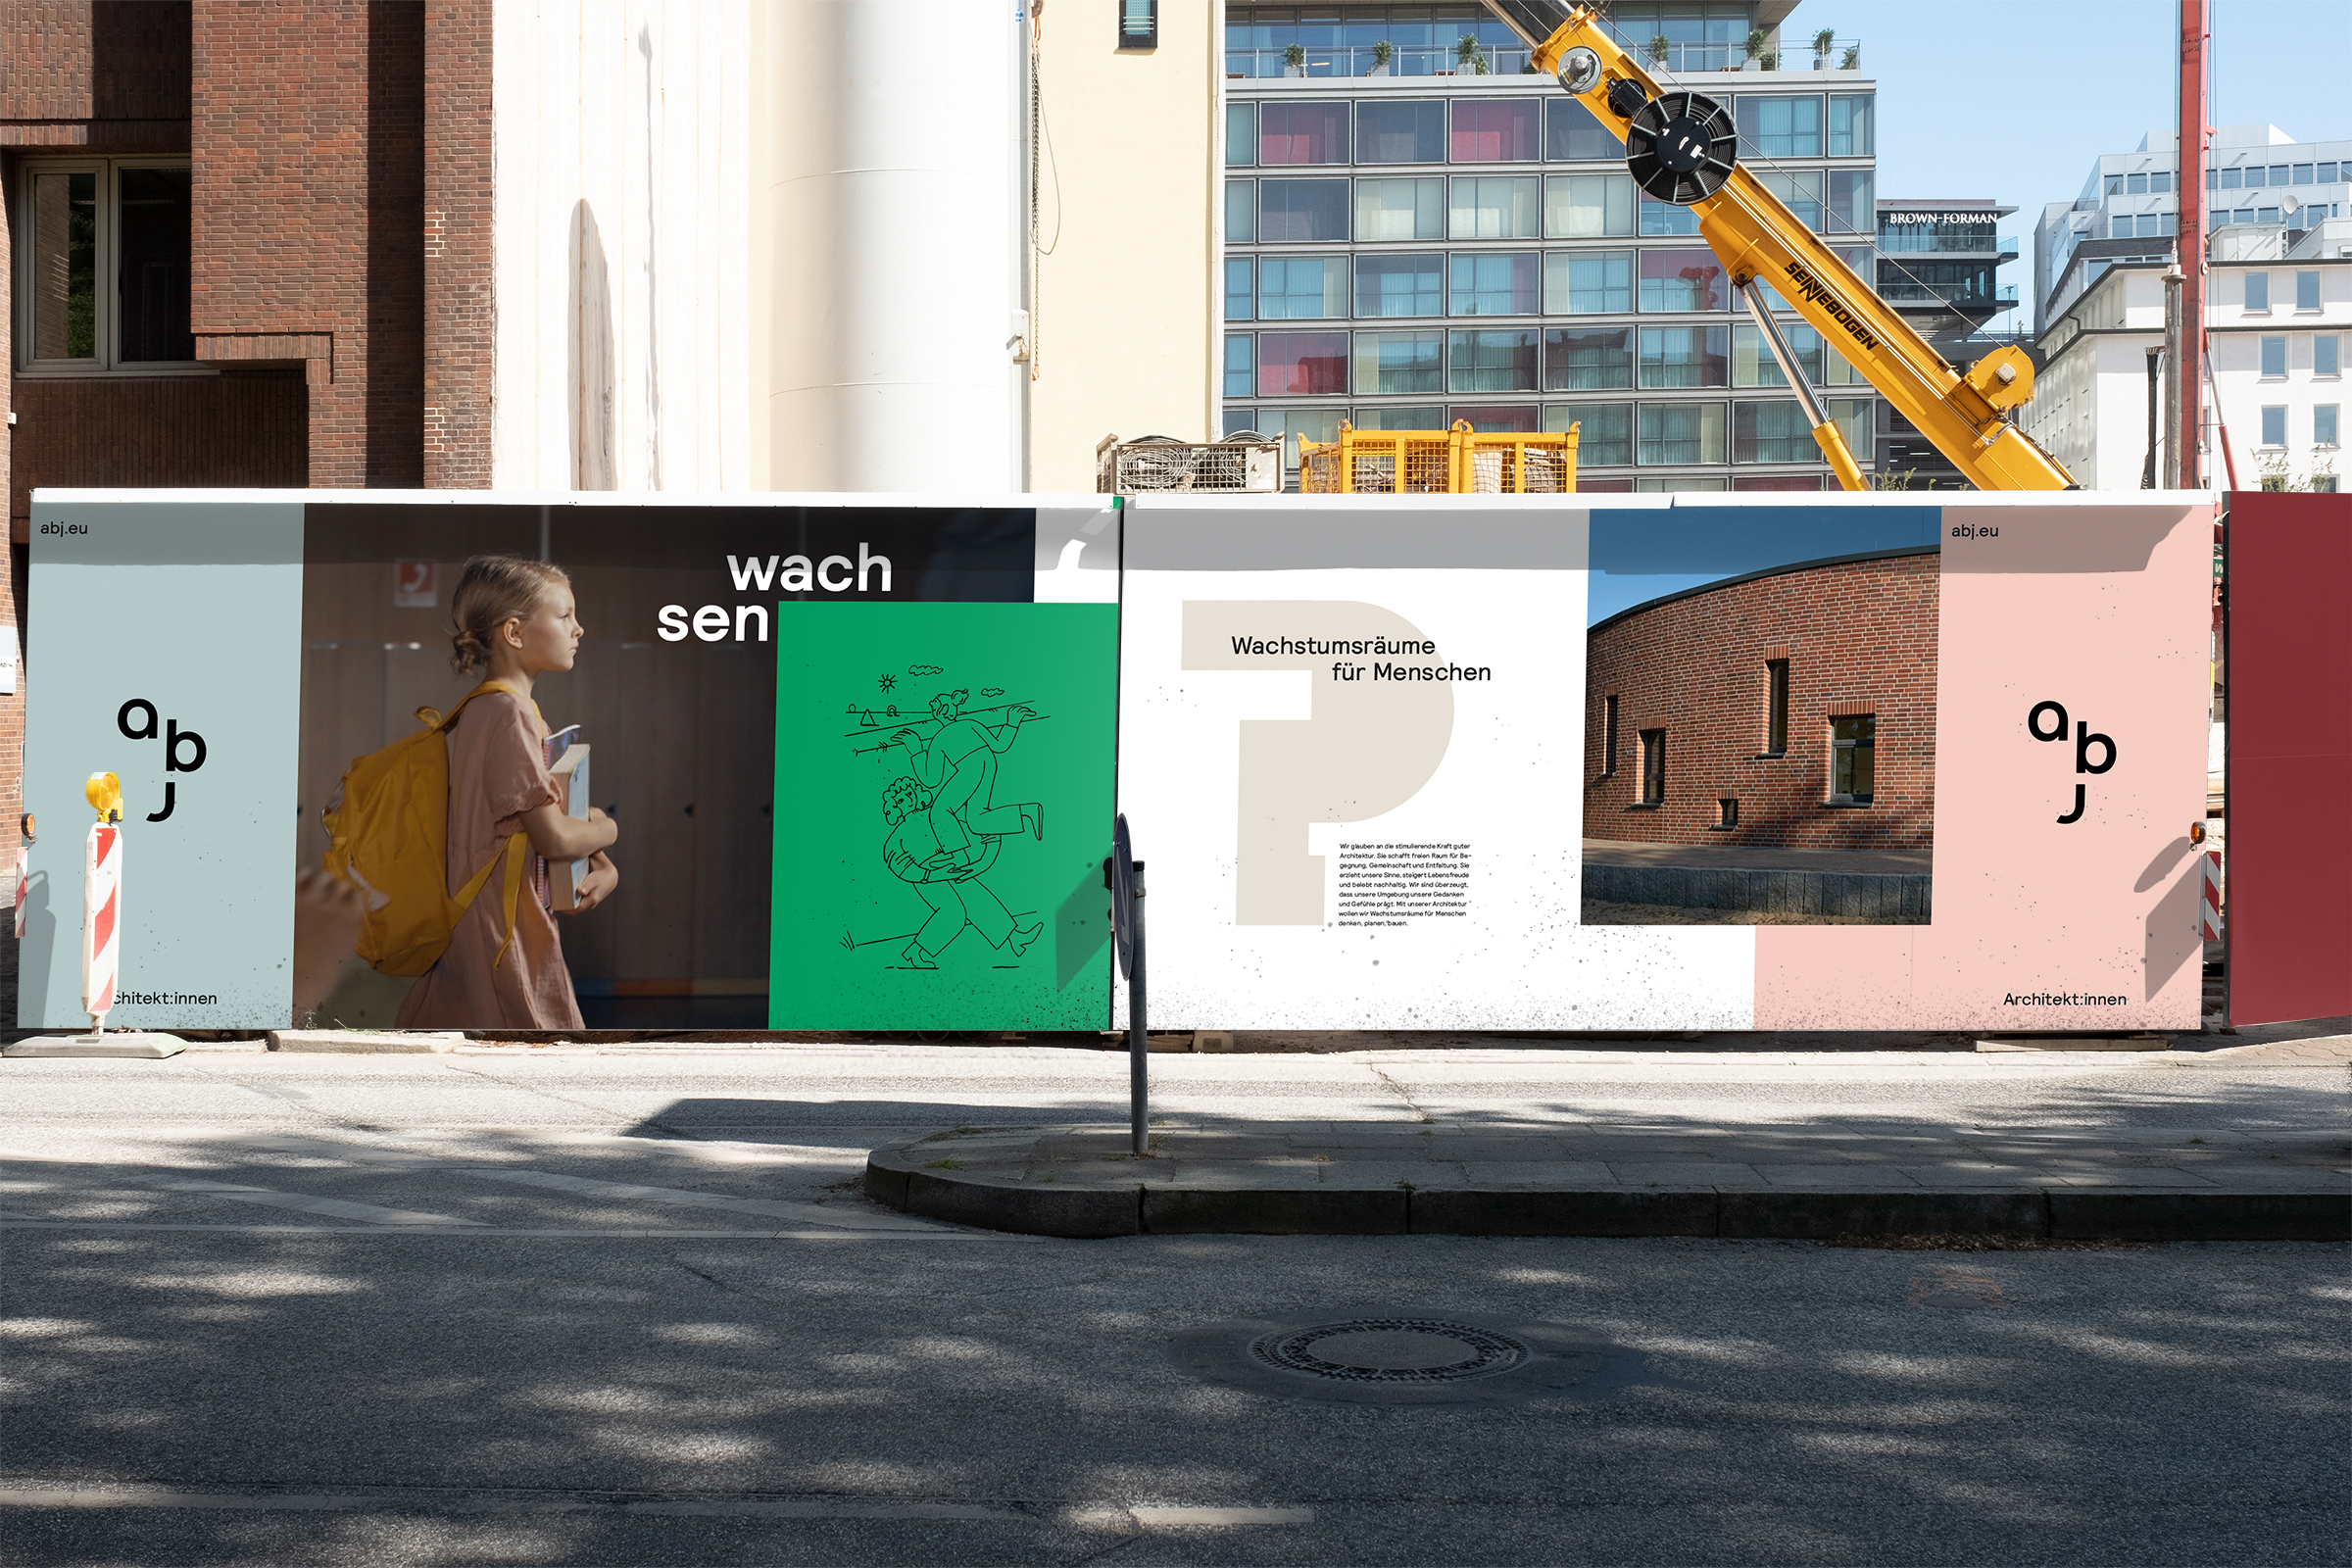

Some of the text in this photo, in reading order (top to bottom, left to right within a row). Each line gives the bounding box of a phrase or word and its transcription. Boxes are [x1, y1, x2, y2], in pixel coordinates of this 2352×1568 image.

[1889, 212, 1998, 224] BROWN-FORMAN
[40, 520, 88, 538] abj.eu
[1951, 523, 1999, 541] abj.eu
[726, 543, 892, 593] wach
[657, 604, 768, 642] sen
[1231, 635, 1436, 656] Wachstumsräume
[1332, 662, 1492, 682] für Menschen
[113, 991, 218, 1005] chitekt:innen
[2003, 993, 2127, 1006] Architekt:innen
